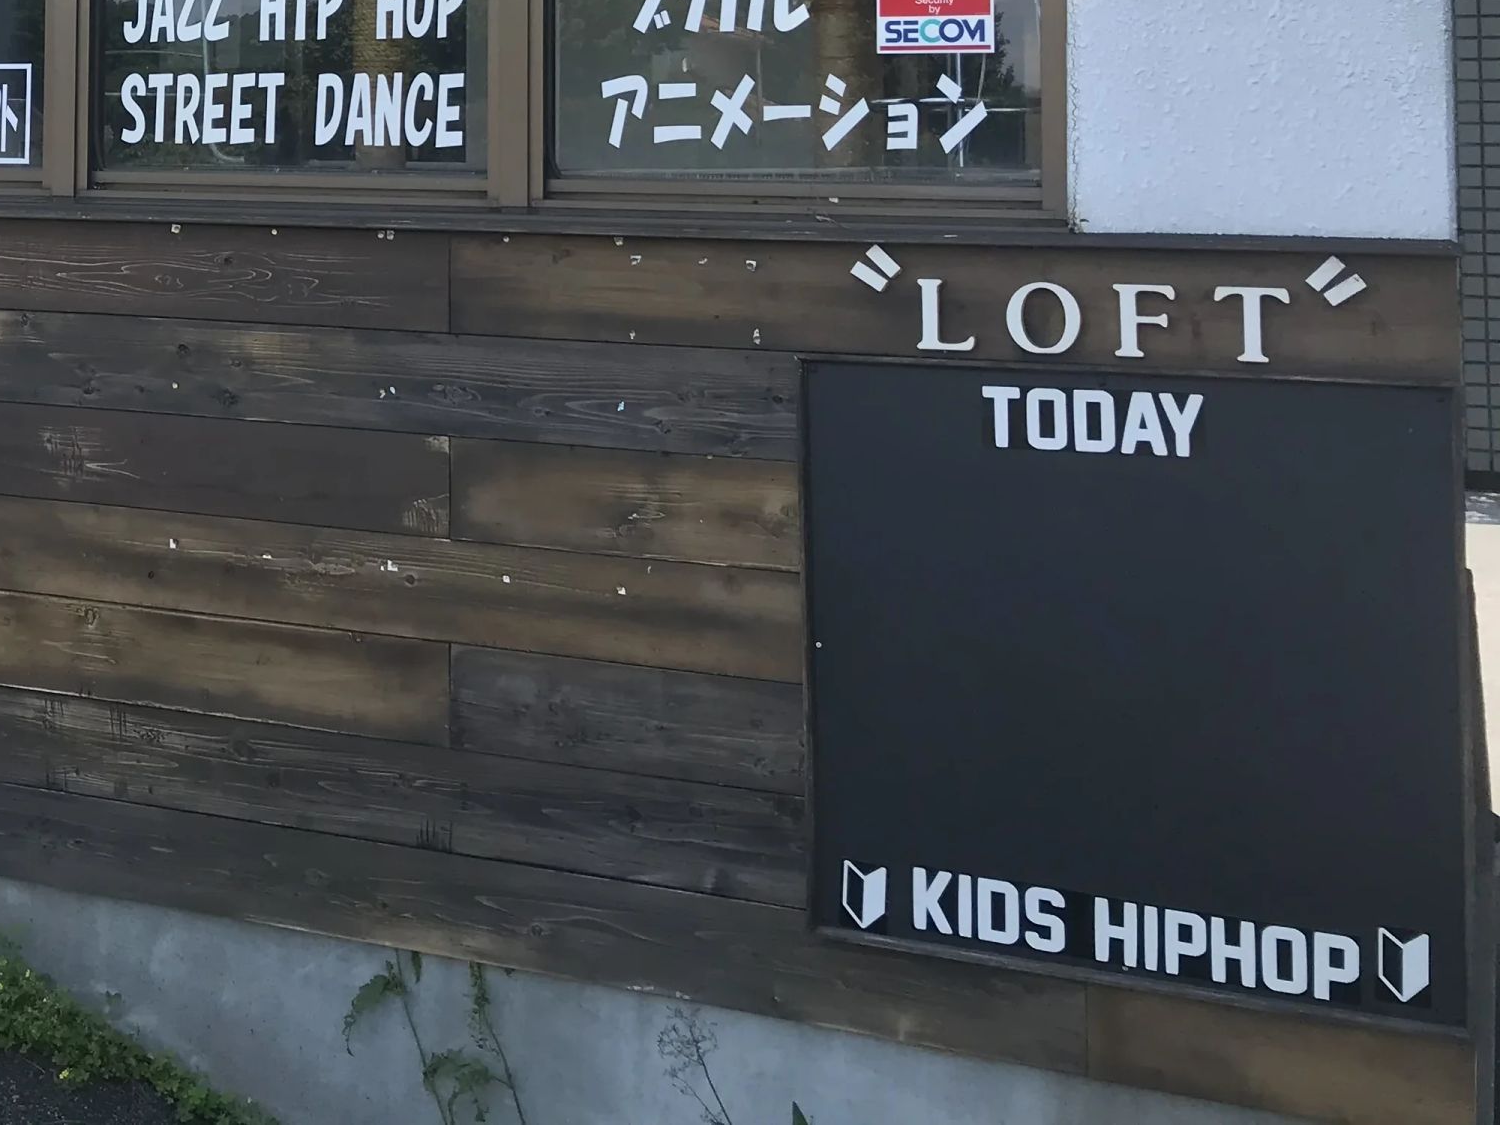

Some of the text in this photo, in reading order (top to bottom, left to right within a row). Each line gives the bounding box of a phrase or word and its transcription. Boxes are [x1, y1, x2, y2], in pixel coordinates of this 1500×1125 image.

[884, 18, 985, 43] SECOM
[928, 4, 941, 15] by
[120, 72, 465, 148] STREET DANCE
[601, 73, 988, 154] アニメーション
[981, 384, 1204, 458] TODAY
[910, 864, 1362, 1003] KIDS HIPHOP
